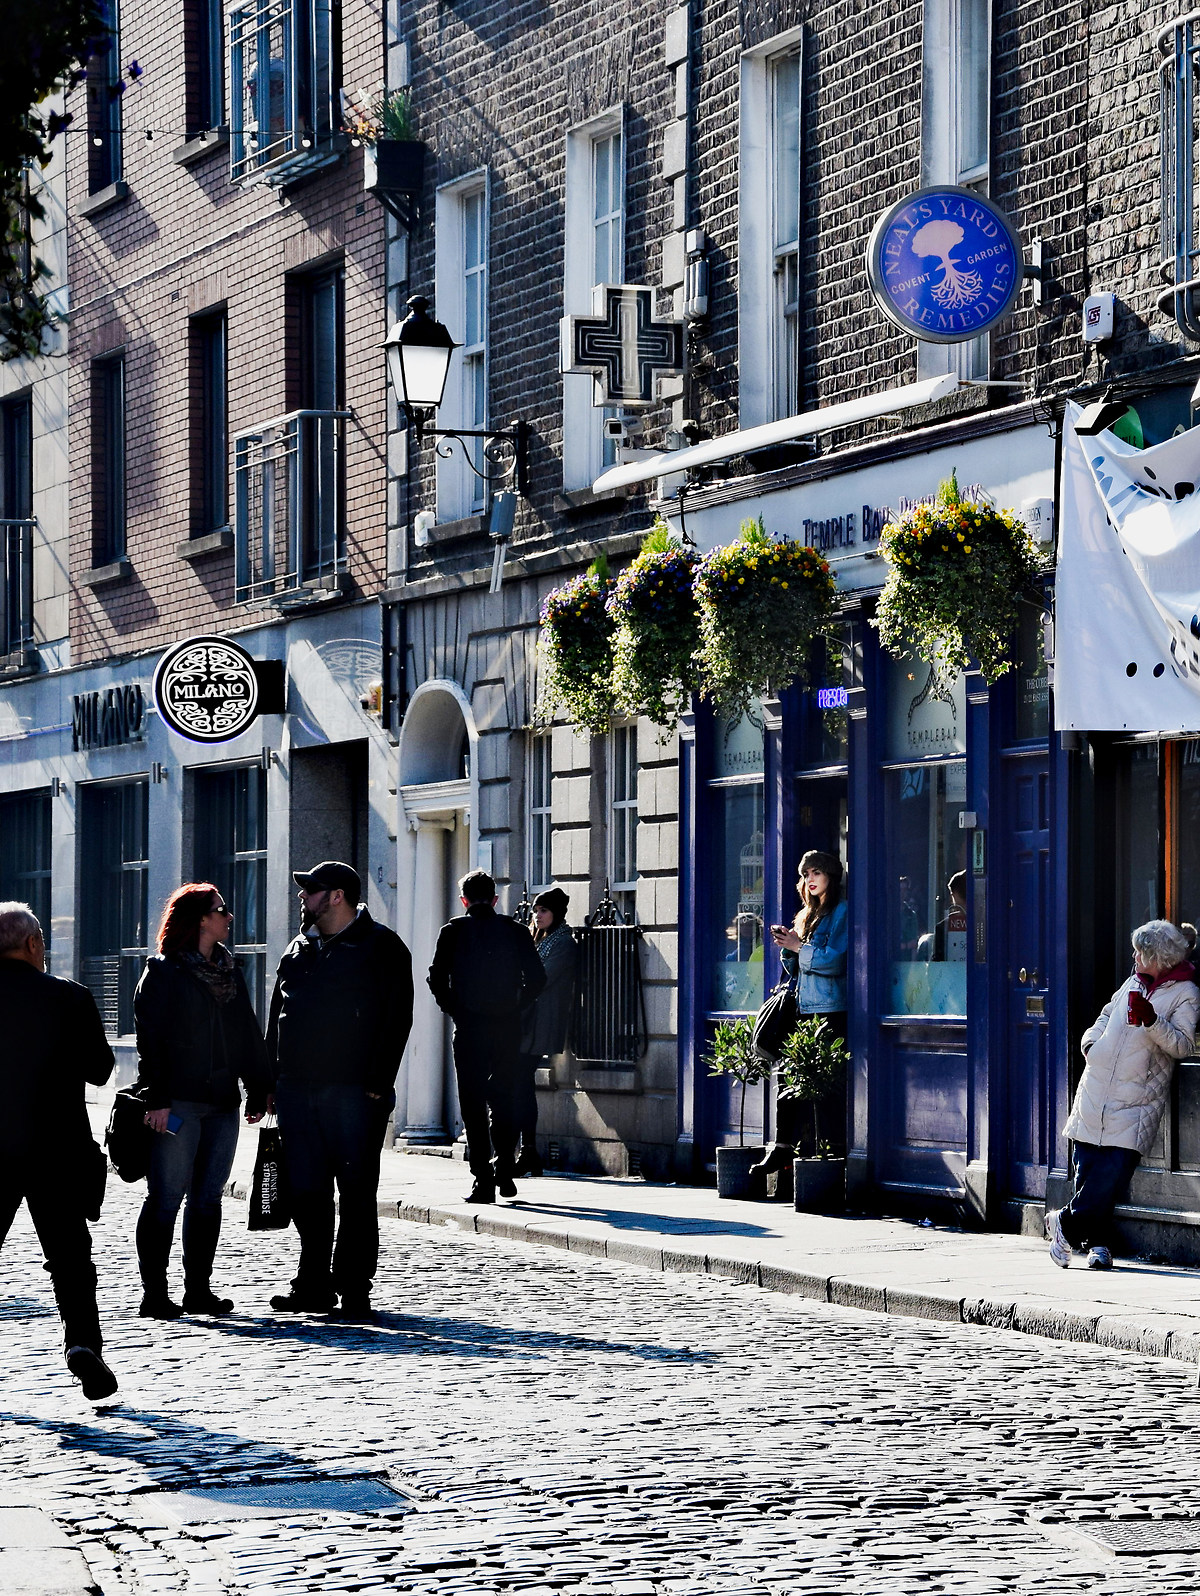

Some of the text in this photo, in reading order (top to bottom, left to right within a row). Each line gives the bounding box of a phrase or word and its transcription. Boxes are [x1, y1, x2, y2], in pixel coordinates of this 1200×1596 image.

[885, 200, 998, 277] NEAL'S YARD
[891, 243, 1007, 294] COVENT GARDEN
[903, 263, 1010, 329] REMEDIES
[803, 514, 854, 550] TEMPLE
[174, 684, 245, 700] MILANO
[72, 684, 144, 752] MILANO
[261, 1163, 271, 1215] STOREHOUSE
[270, 1161, 278, 1202] GUINNESS
